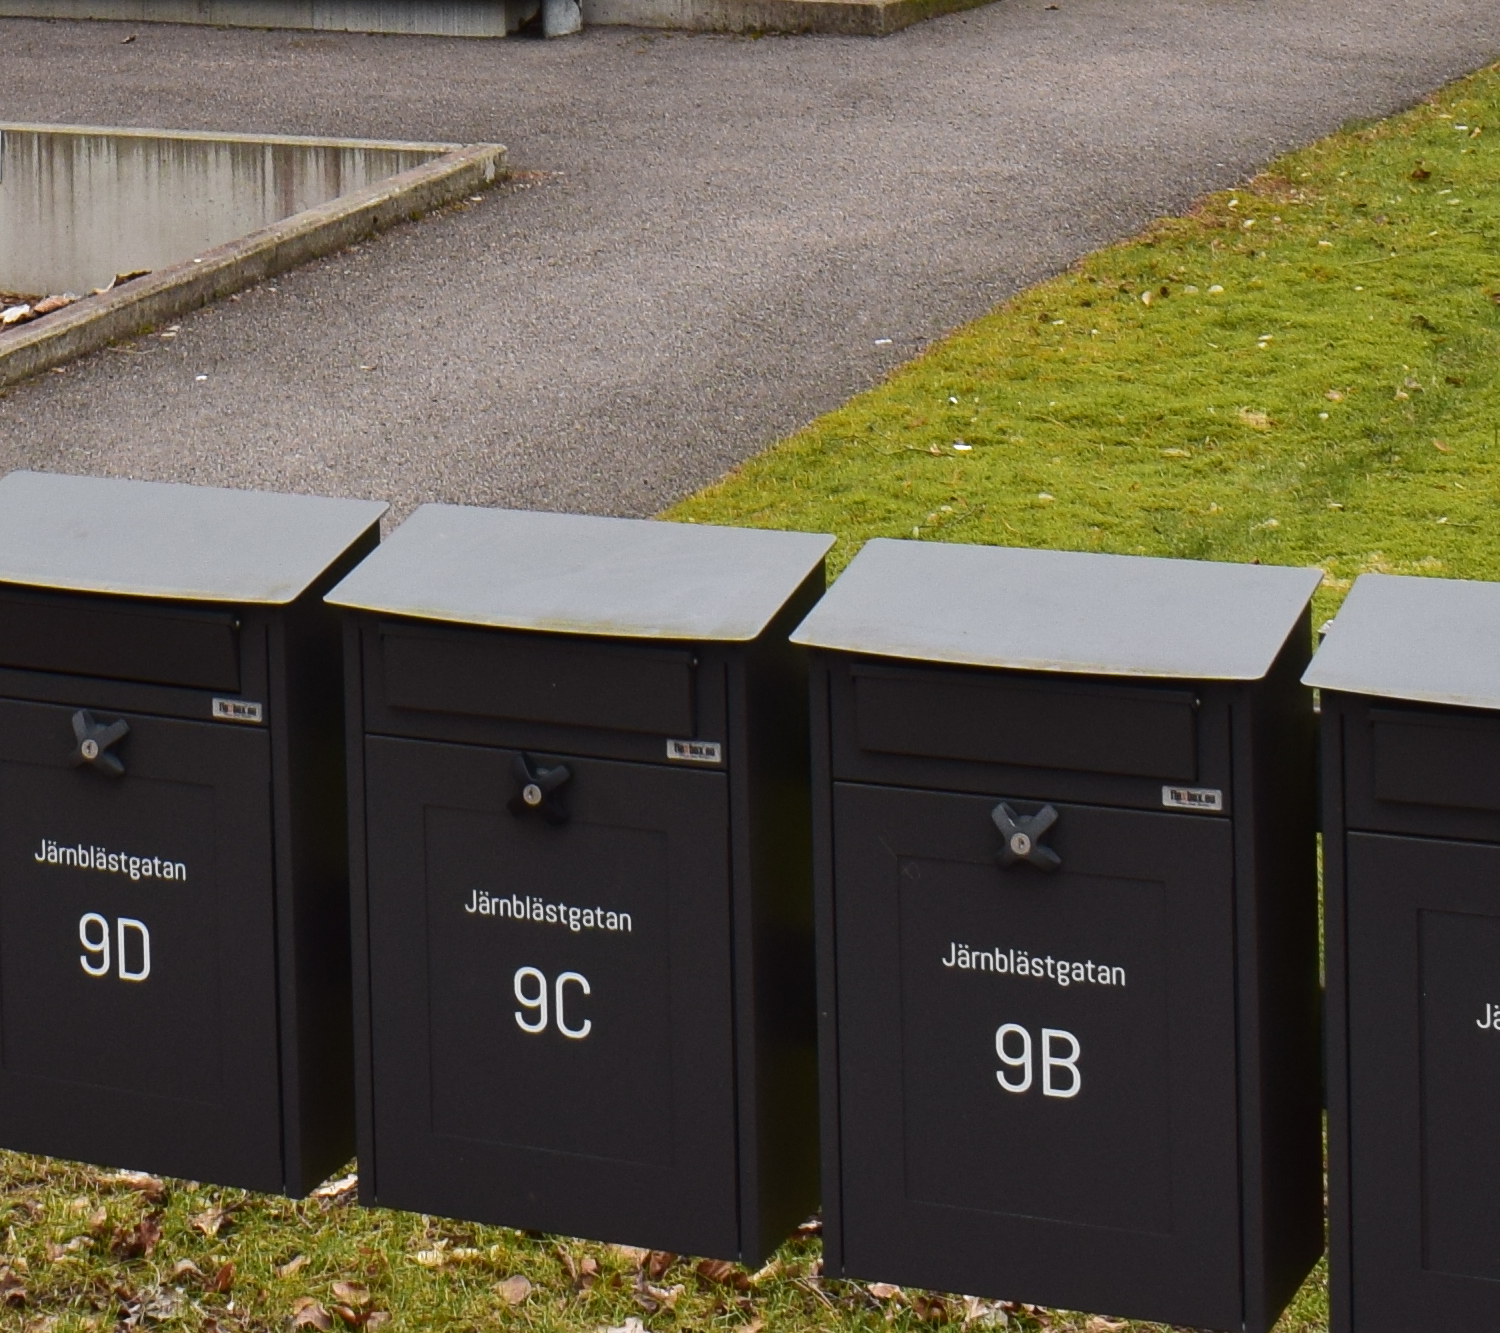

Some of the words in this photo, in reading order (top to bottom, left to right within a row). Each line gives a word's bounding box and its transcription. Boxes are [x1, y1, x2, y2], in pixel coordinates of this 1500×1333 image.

[34, 838, 187, 882] Järnblästgatan
[464, 889, 632, 933] Järnblästgatan
[78, 912, 151, 982] 9D
[941, 941, 1126, 987] Järnblästgatan
[513, 966, 592, 1040] 9C
[995, 1022, 1082, 1099] 9B
